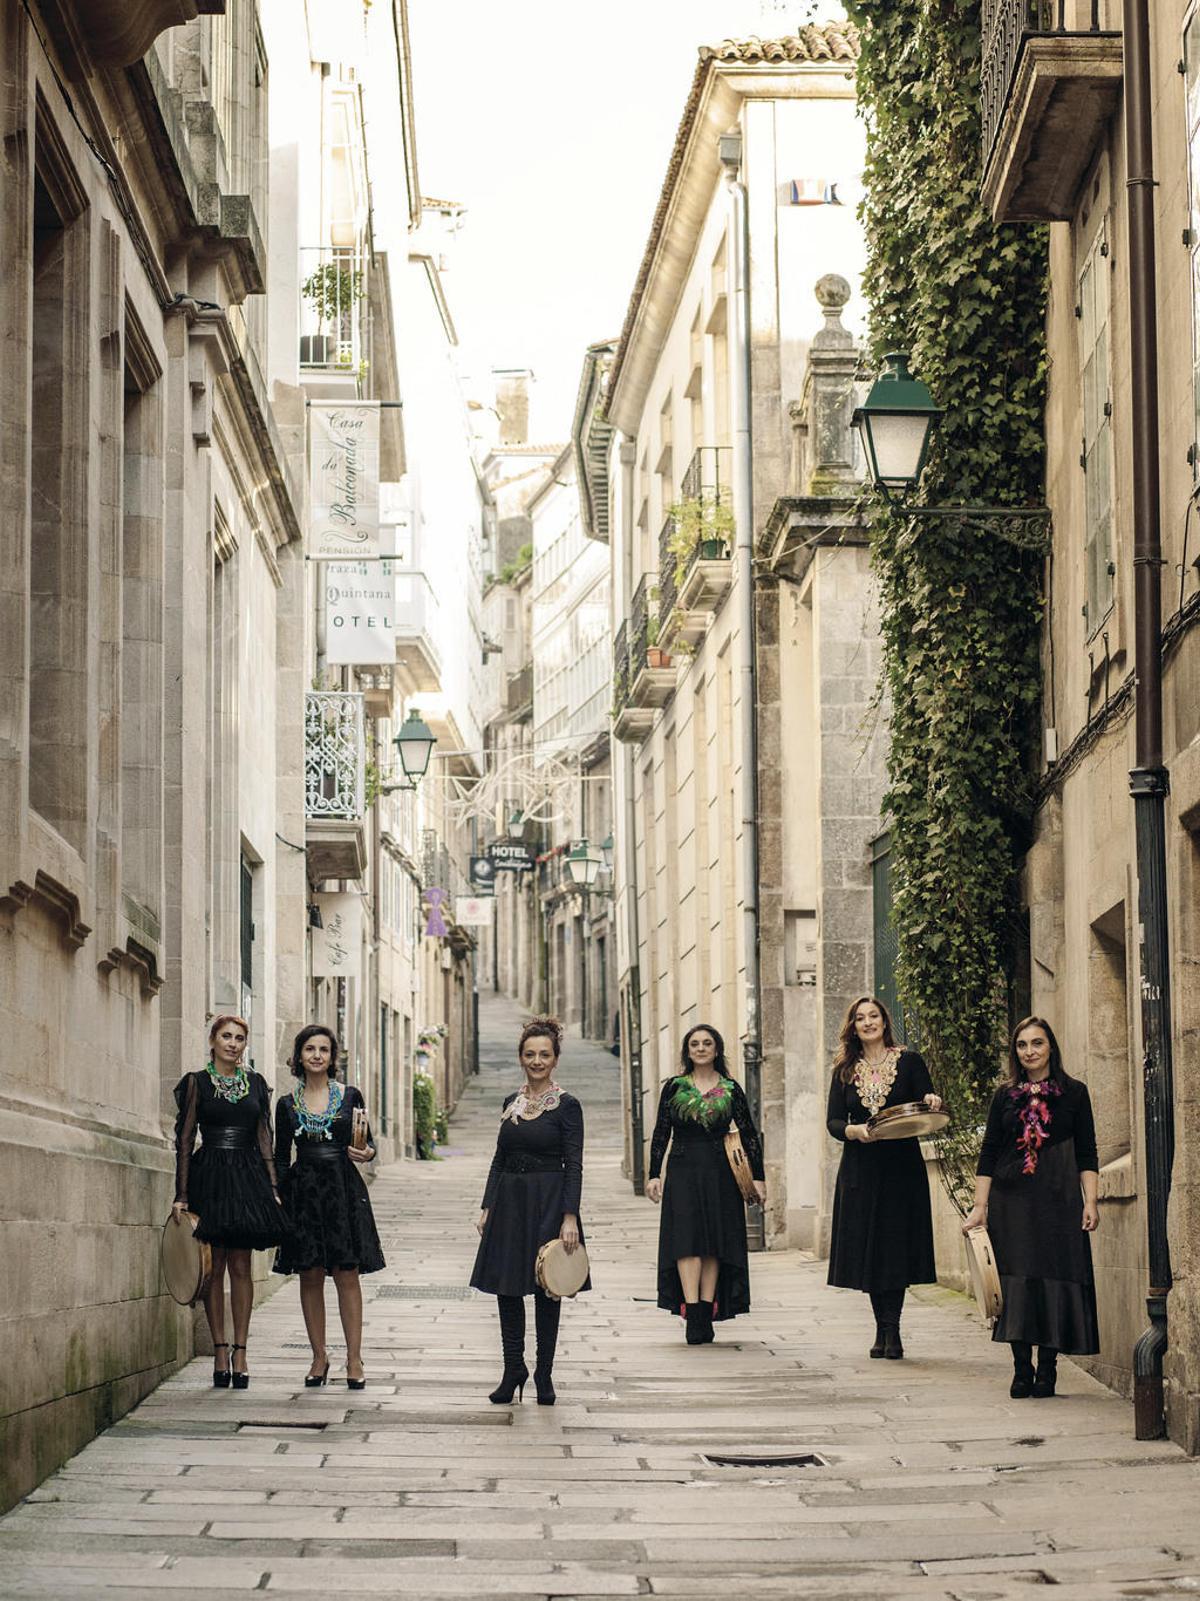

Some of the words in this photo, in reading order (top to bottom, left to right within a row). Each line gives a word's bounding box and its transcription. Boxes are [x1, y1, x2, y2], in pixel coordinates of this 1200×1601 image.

[327, 411, 364, 429] Casa
[321, 456, 338, 471] da
[328, 437, 365, 526] Balconada
[326, 585, 392, 607] Quintana
[333, 615, 393, 629] OTEL
[491, 845, 529, 858] HOTEL
